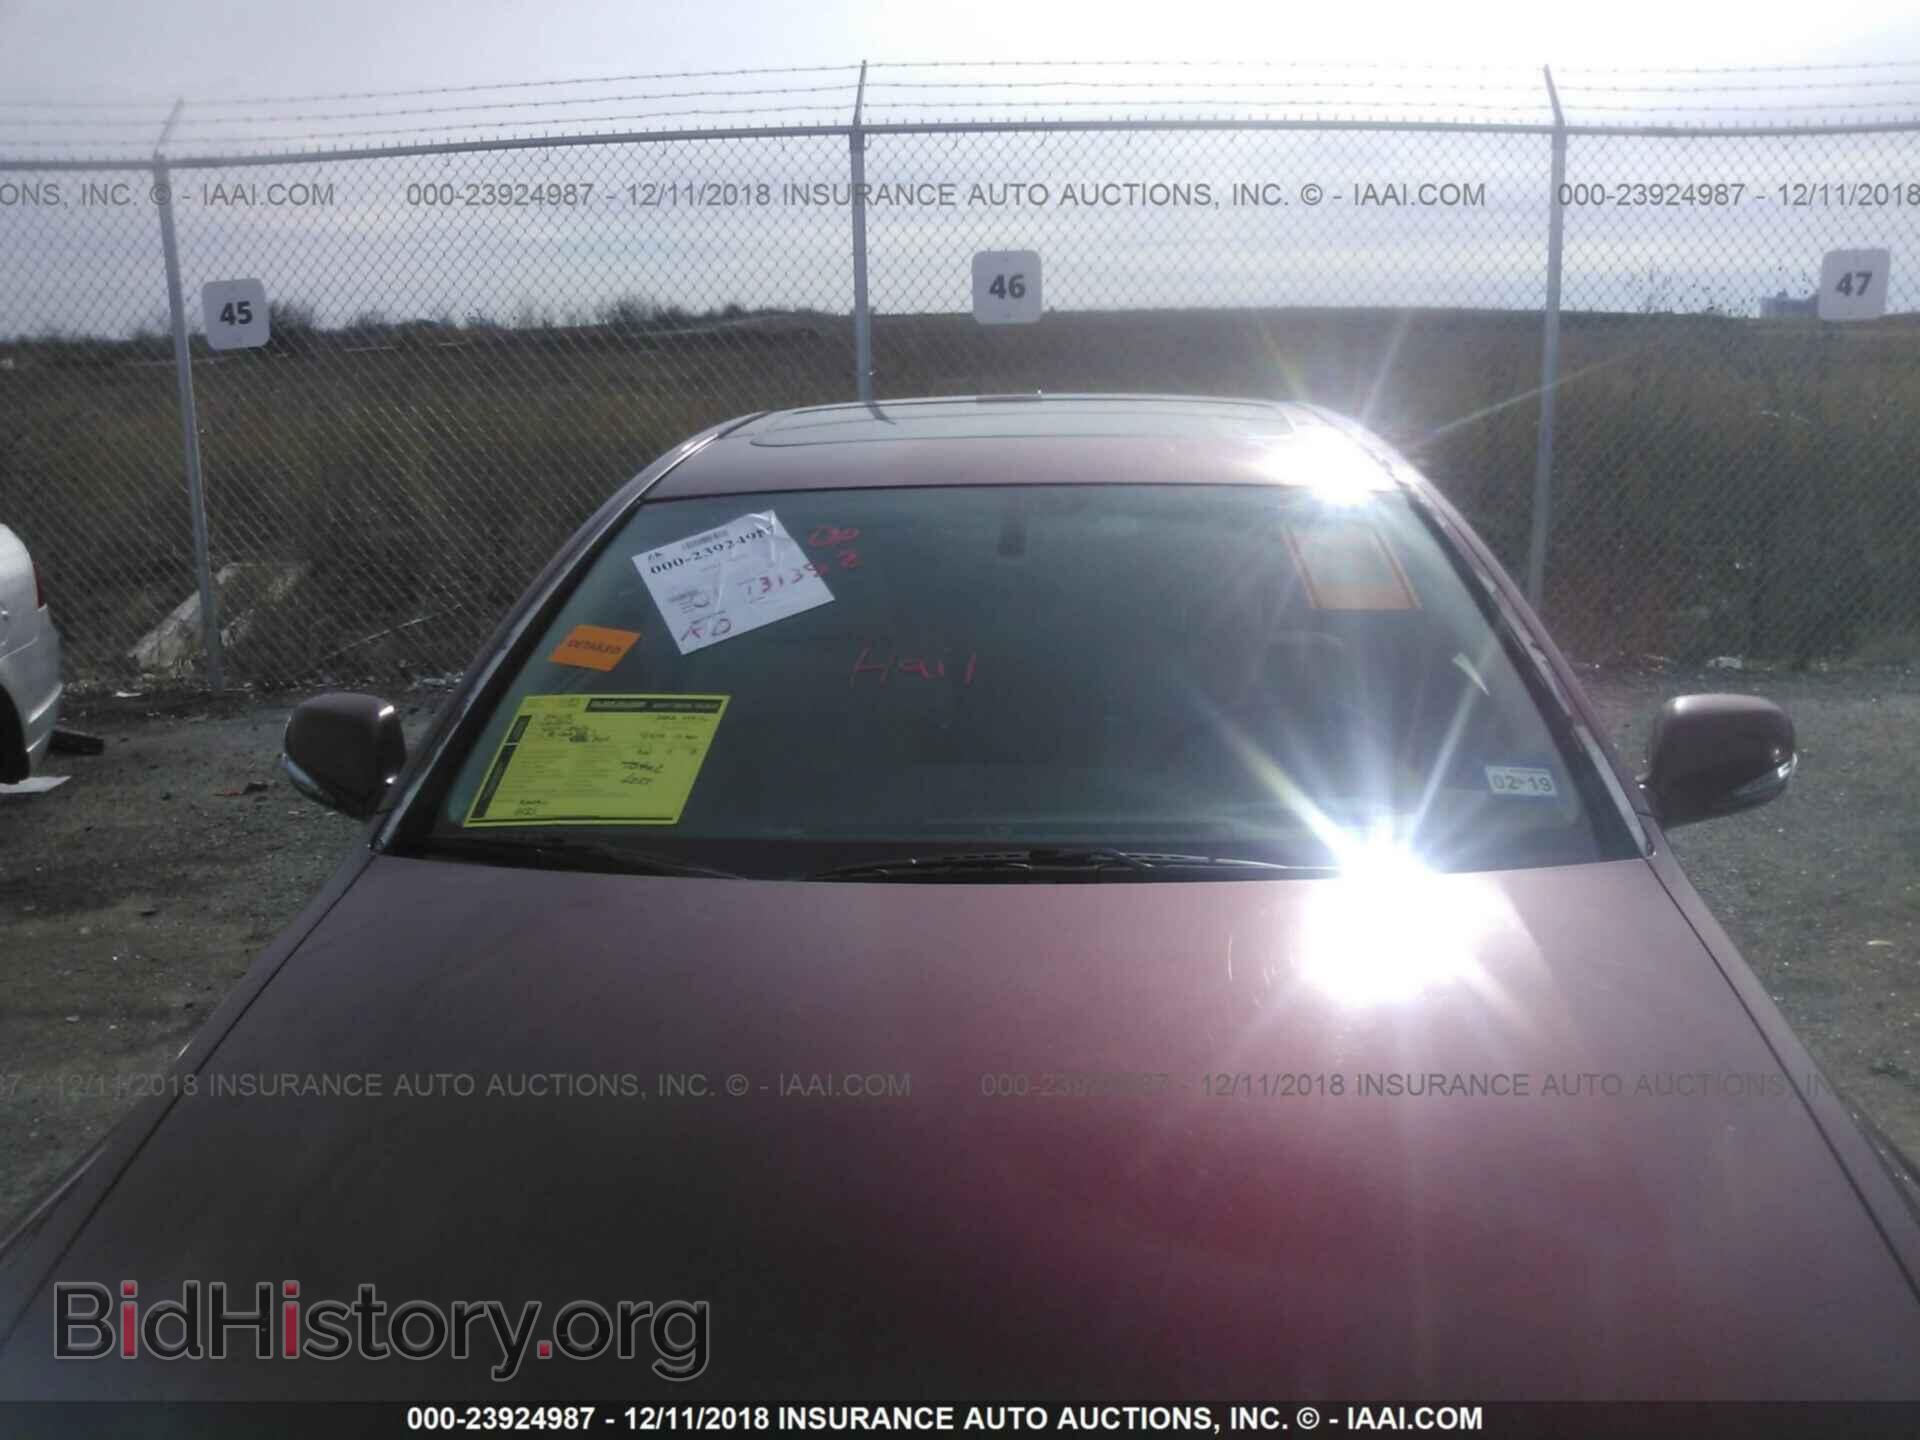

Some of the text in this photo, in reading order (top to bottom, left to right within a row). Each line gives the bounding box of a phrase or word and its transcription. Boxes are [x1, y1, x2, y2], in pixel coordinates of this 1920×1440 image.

[989, 273, 1026, 299] 46
[1835, 269, 1873, 297] 47
[219, 301, 253, 326] 45
[650, 525, 774, 574] 000-239249
